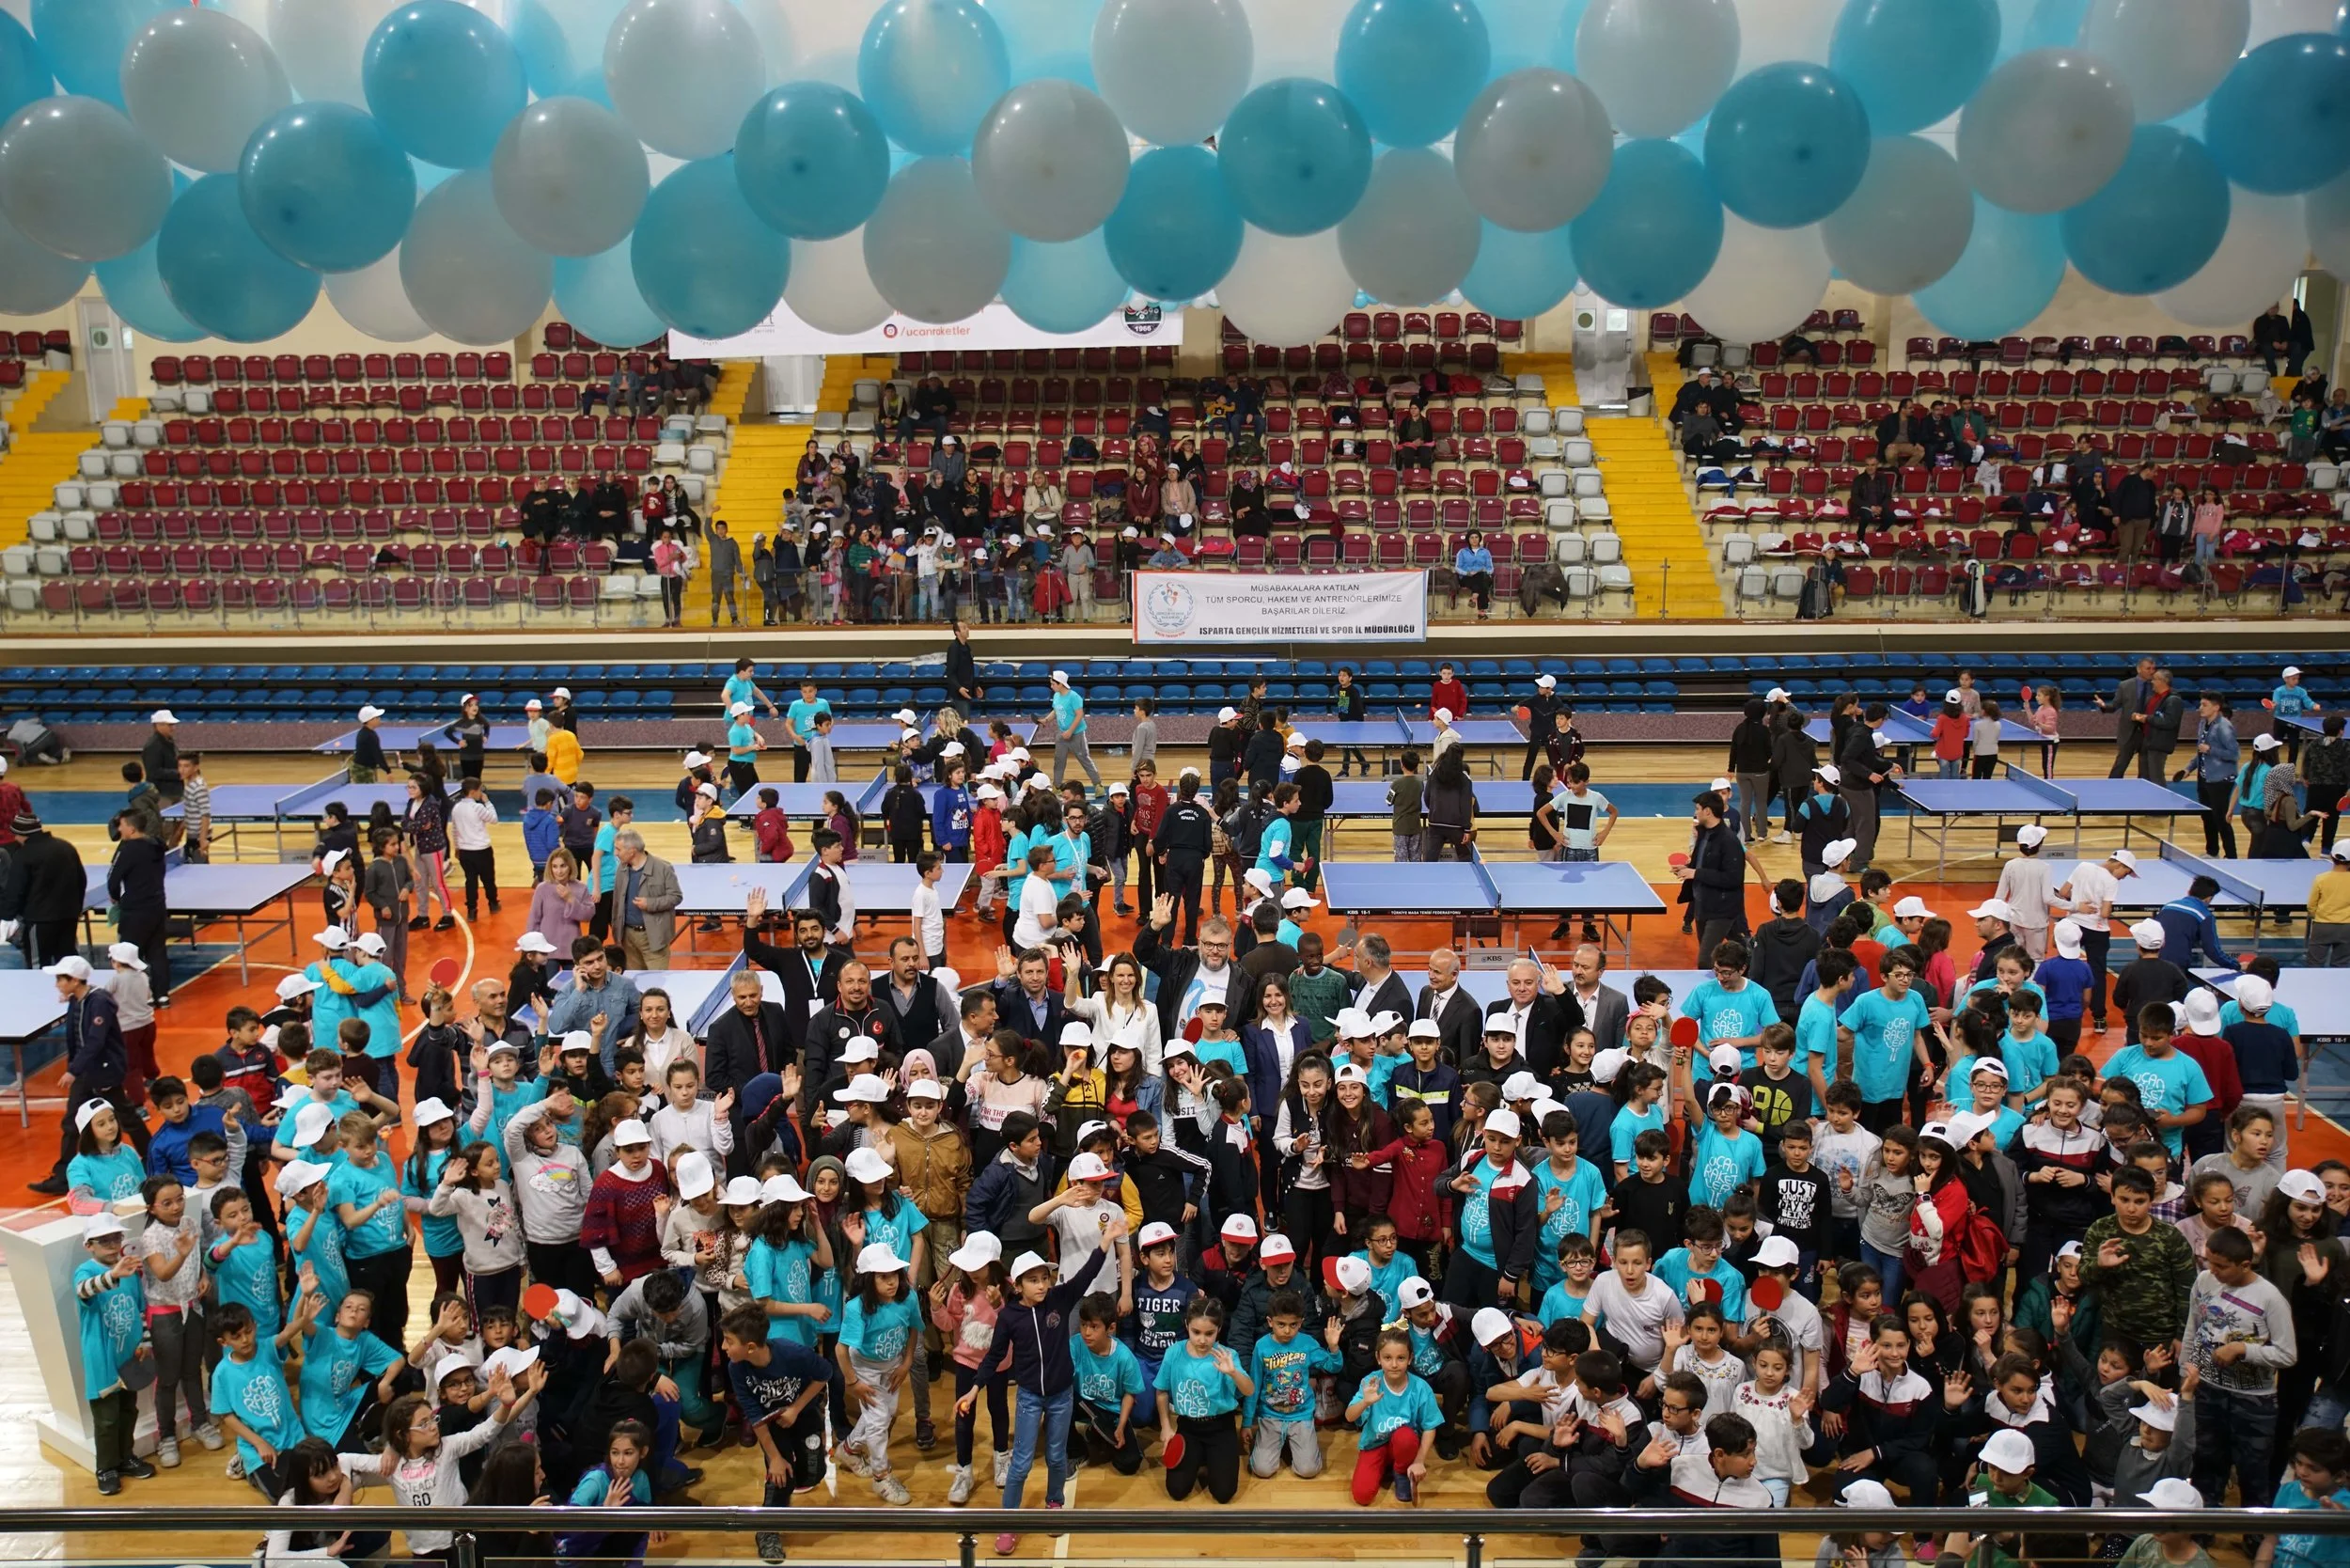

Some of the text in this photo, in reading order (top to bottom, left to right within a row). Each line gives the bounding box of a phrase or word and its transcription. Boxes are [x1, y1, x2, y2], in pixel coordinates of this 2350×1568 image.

[1250, 584, 1321, 592] MÜSABAKALARA
[1205, 595, 1224, 604] TÜM
[1226, 596, 1265, 604] SPORCU,
[1315, 594, 1402, 603] ANTRENÖRLERİMİZE
[1261, 607, 1310, 616] BAŞARILAR
[1199, 626, 1234, 635] ISPARTA
[1235, 625, 1270, 635] GENÇLİK
[1272, 625, 1319, 635] HİZMETLERİ
[1355, 624, 1363, 634] İL
[1364, 623, 1415, 634] MÜDÜRLÜĞÜ
[1716, 1009, 1743, 1023] UÇAN
[1713, 1019, 1744, 1035] RAKET
[2133, 1072, 2165, 1089] UÇAN
[993, 1107, 1005, 1118] THE
[1708, 1155, 1738, 1174] UÇAN
[1703, 1164, 1738, 1186] RAKET
[1780, 1180, 1817, 1197] JUST
[1781, 1193, 1812, 1202] ANOTHER
[1778, 1200, 1800, 1213] DAY
[1781, 1210, 1810, 1219] BEING
[1137, 1297, 1181, 1313] TIGER
[1178, 1378, 1208, 1398] UÇAN
[412, 1492, 431, 1507] GO
